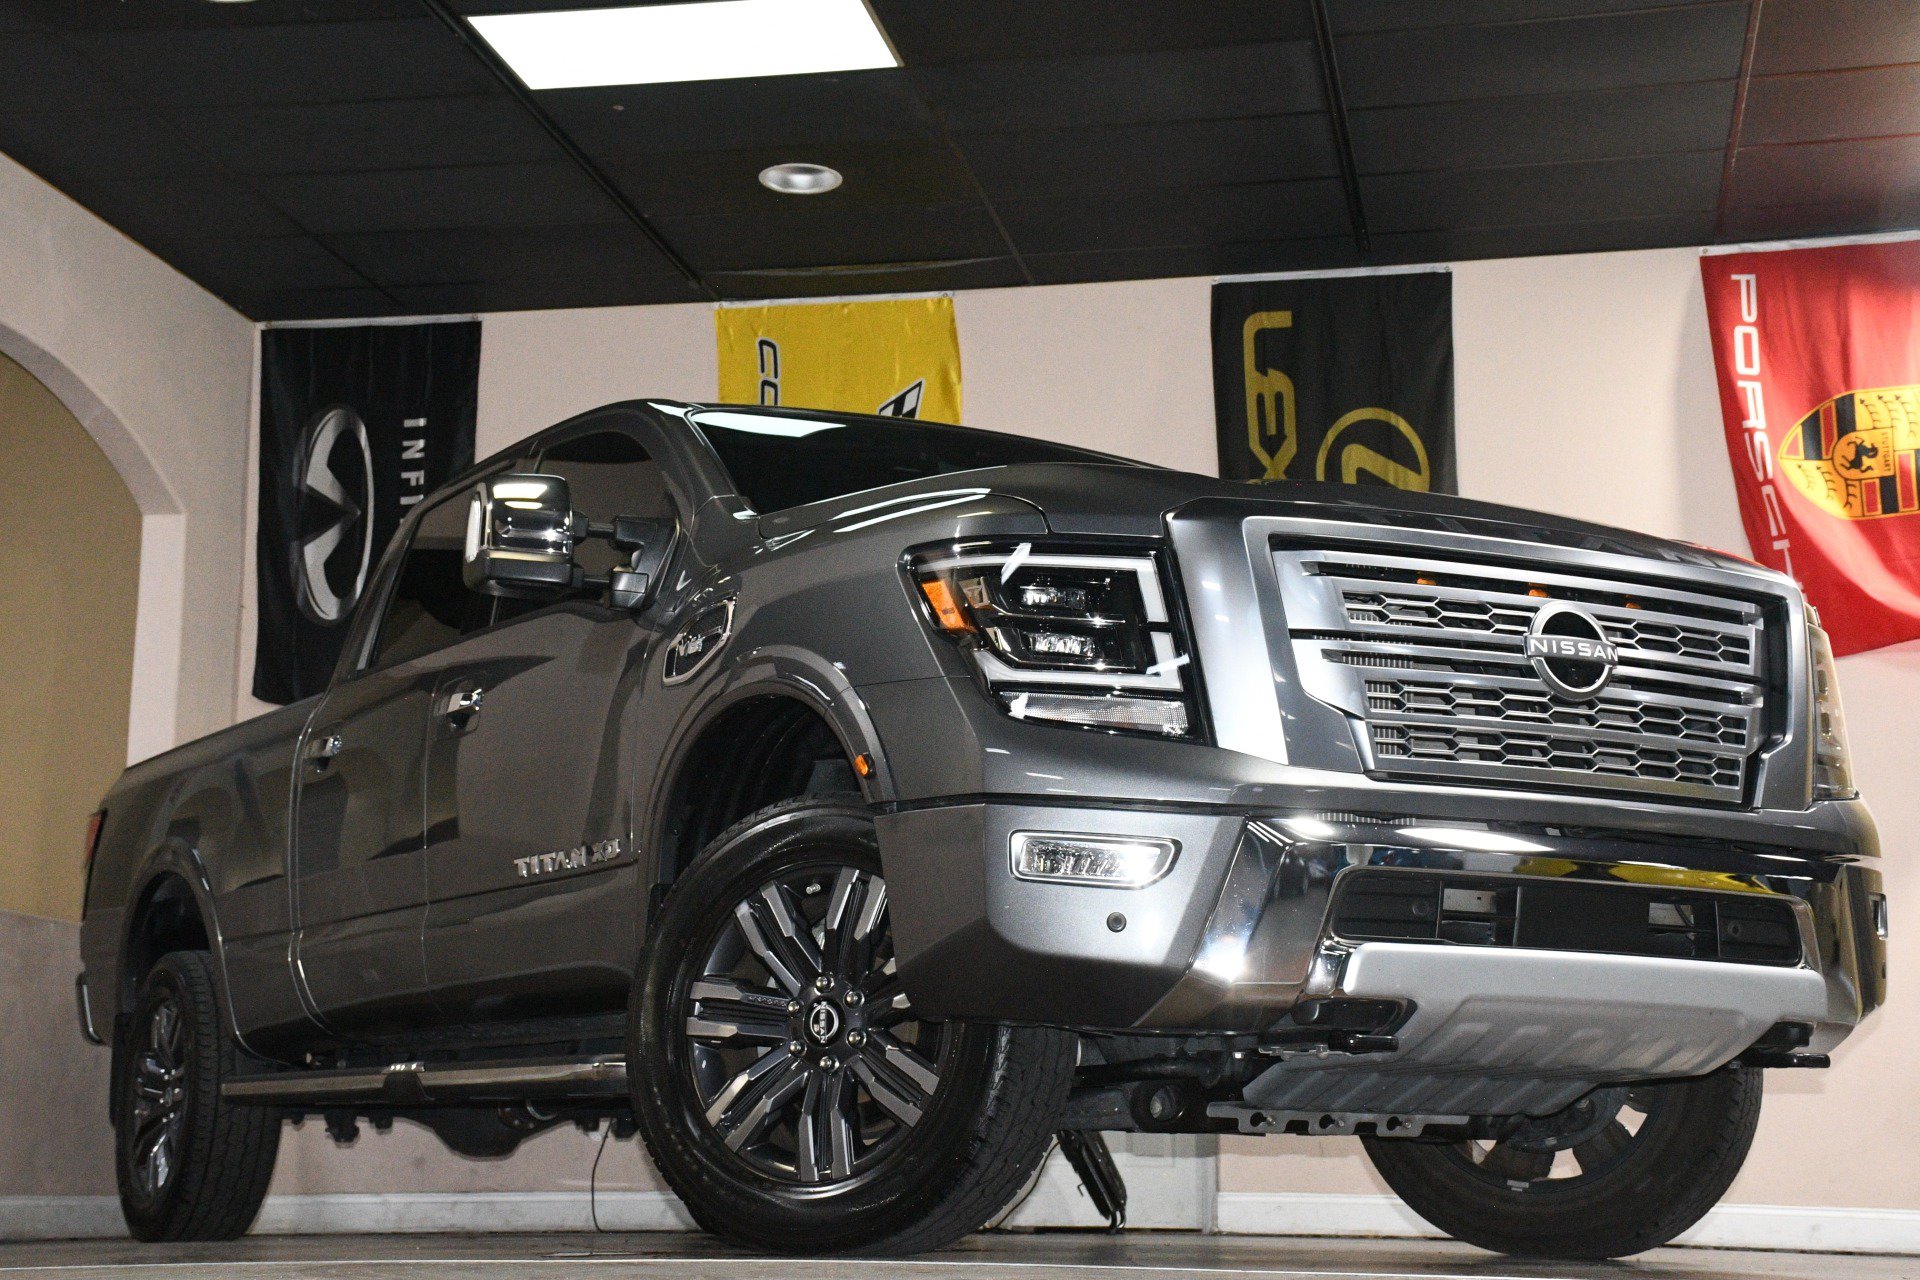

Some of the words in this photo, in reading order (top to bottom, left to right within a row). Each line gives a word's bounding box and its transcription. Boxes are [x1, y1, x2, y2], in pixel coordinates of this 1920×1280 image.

[1731, 273, 1808, 603] PORSCH
[399, 418, 427, 524] INFI
[1530, 639, 1618, 662] NISSAN
[513, 843, 589, 878] TITAN
[820, 1001, 828, 1043] NISSAN
